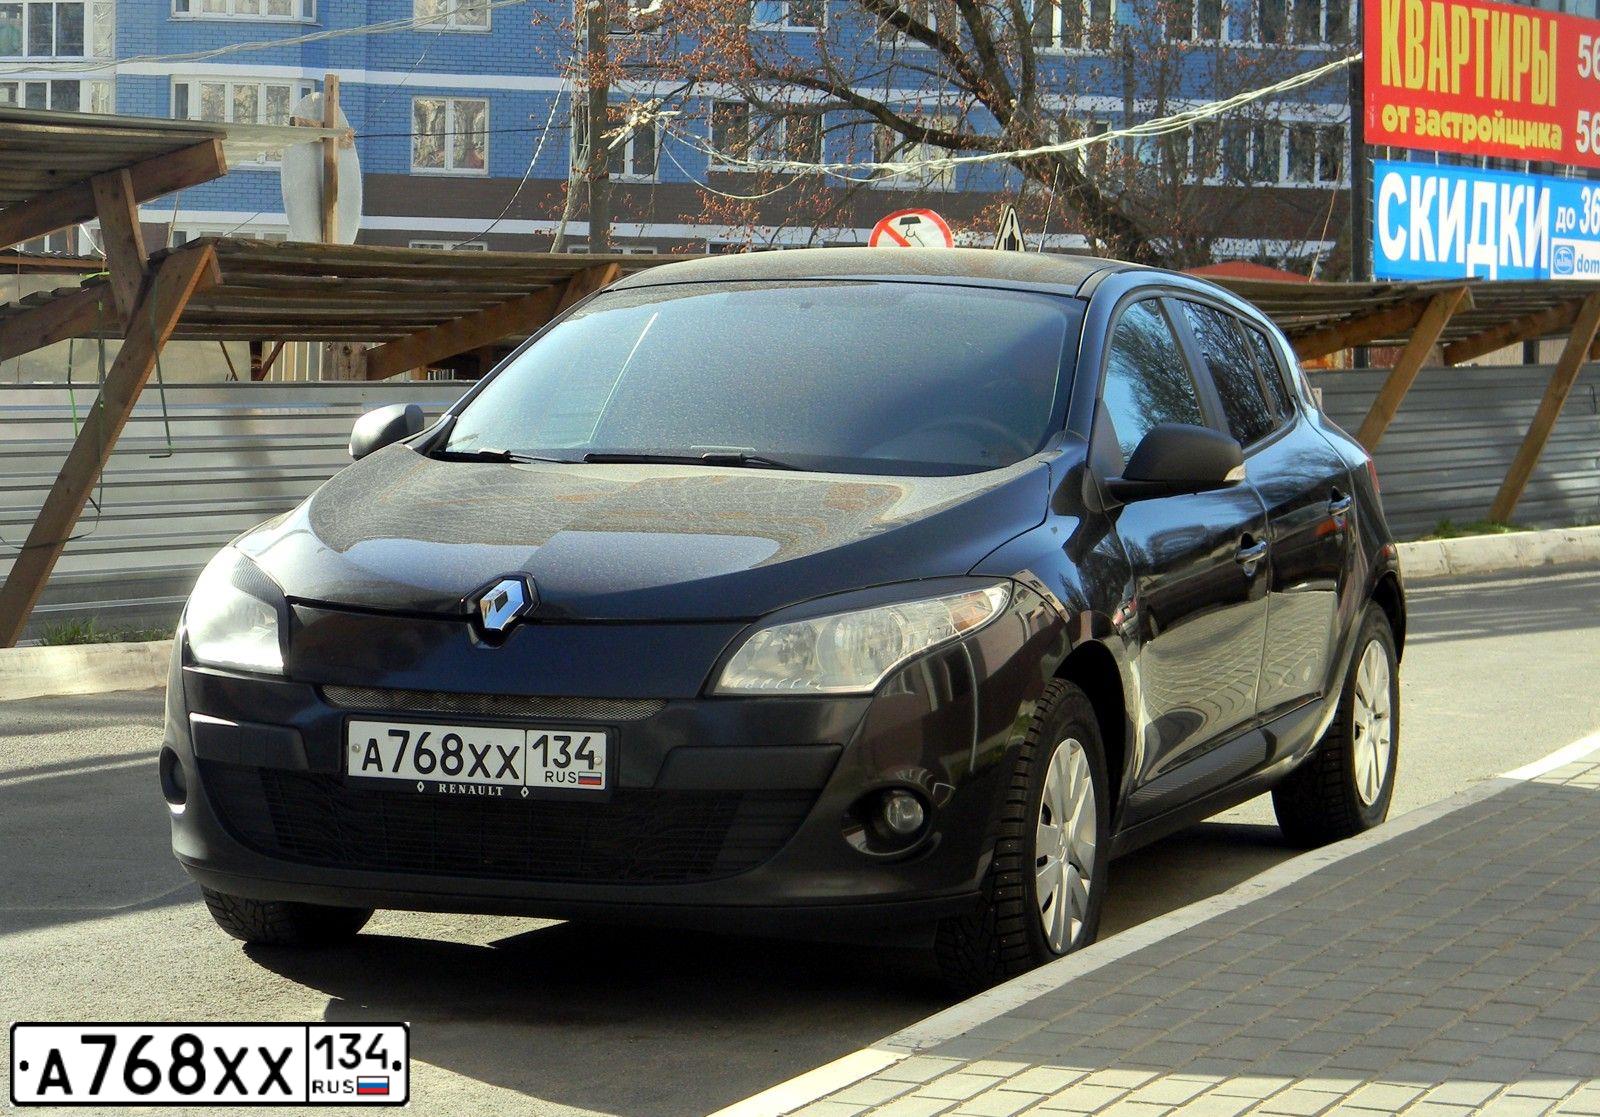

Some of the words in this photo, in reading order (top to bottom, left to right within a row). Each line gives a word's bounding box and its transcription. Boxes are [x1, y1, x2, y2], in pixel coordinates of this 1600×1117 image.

[1381, 0, 1557, 107] КВАРТИРЫ
[1382, 104, 1410, 133] от
[1415, 107, 1562, 151] застройщика
[1378, 172, 1550, 280] СКИДКИ
[1556, 206, 1576, 234] до
[1579, 186, 1600, 235] 36
[532, 734, 595, 770] 134
[439, 783, 504, 796] RENAULT
[544, 771, 577, 784] RUS
